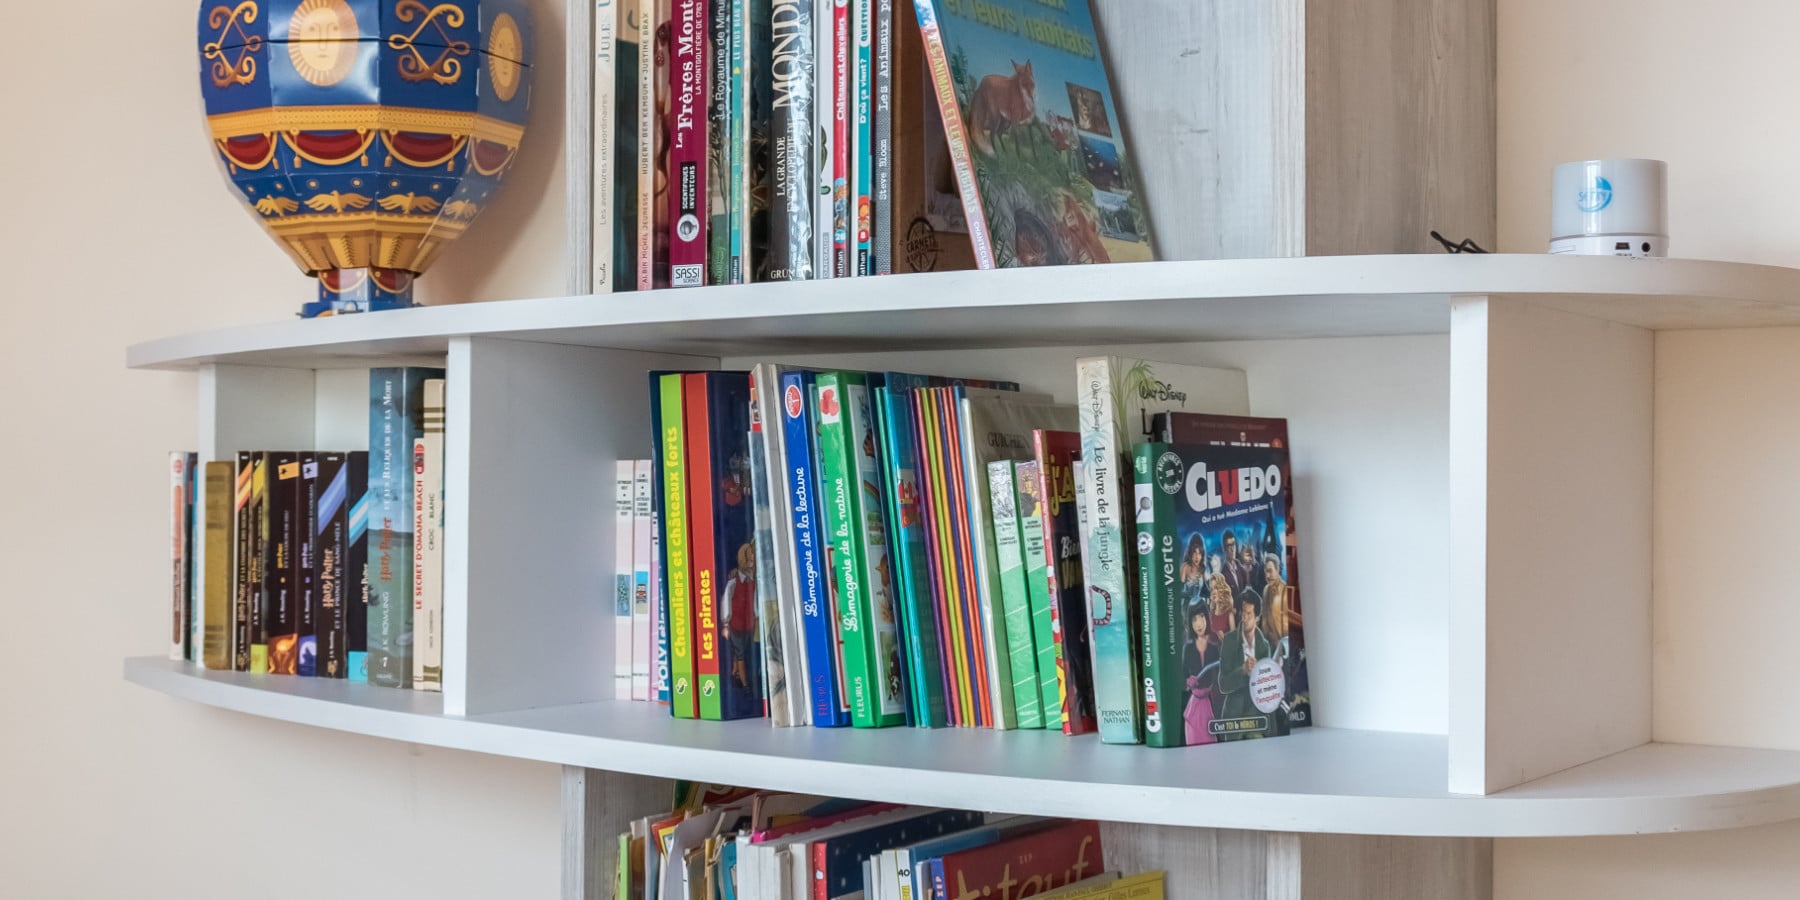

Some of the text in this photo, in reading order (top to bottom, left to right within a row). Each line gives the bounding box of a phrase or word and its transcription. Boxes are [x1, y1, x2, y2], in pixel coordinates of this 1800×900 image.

[696, 19, 702, 29] DE
[733, 30, 741, 48] PLUS
[836, 17, 845, 120] Châteaux et chevaliers
[879, 19, 888, 78] Animaux
[678, 62, 693, 131] Frères
[696, 85, 702, 95] LA
[716, 33, 727, 120] Le Royaume de
[860, 89, 869, 100] ça
[859, 102, 867, 124] D'où
[879, 85, 888, 111] Les
[927, 34, 978, 213] LES ANIMAUX ET LEURS HABITATS
[777, 136, 785, 196] LA GRANDE
[879, 139, 887, 200] Steve Bloom
[675, 267, 699, 279] SASSI
[384, 409, 391, 419] LA
[384, 423, 391, 434] DE
[383, 437, 392, 479] RELIQUES
[1185, 461, 1281, 512] CLUEDO
[1094, 446, 1112, 571] Le livre de la jungle
[1201, 515, 1212, 524] Qui
[1216, 513, 1225, 521] tué
[1226, 509, 1248, 519] Madame
[1249, 503, 1269, 513] Leblanc
[379, 517, 392, 582] Harry Potter
[666, 426, 686, 658] Chevaliers et châteaux forts
[795, 467, 818, 617] L'imagerie de la lecture
[834, 478, 858, 632] L'imagerie de la nature
[1161, 535, 1174, 586] verte
[321, 548, 334, 608] Harry Potter
[334, 609, 341, 618] LE
[334, 621, 341, 629] ET
[416, 600, 422, 610] LE
[699, 569, 715, 660] Les pirates
[1170, 645, 1176, 655] LA
[854, 676, 865, 718] FLEURUS
[1145, 678, 1162, 733] CLUEDO
[1214, 723, 1225, 731] C'est
[1226, 721, 1234, 730] TOI
[1234, 721, 1239, 729] le
[898, 868, 910, 877] 40
